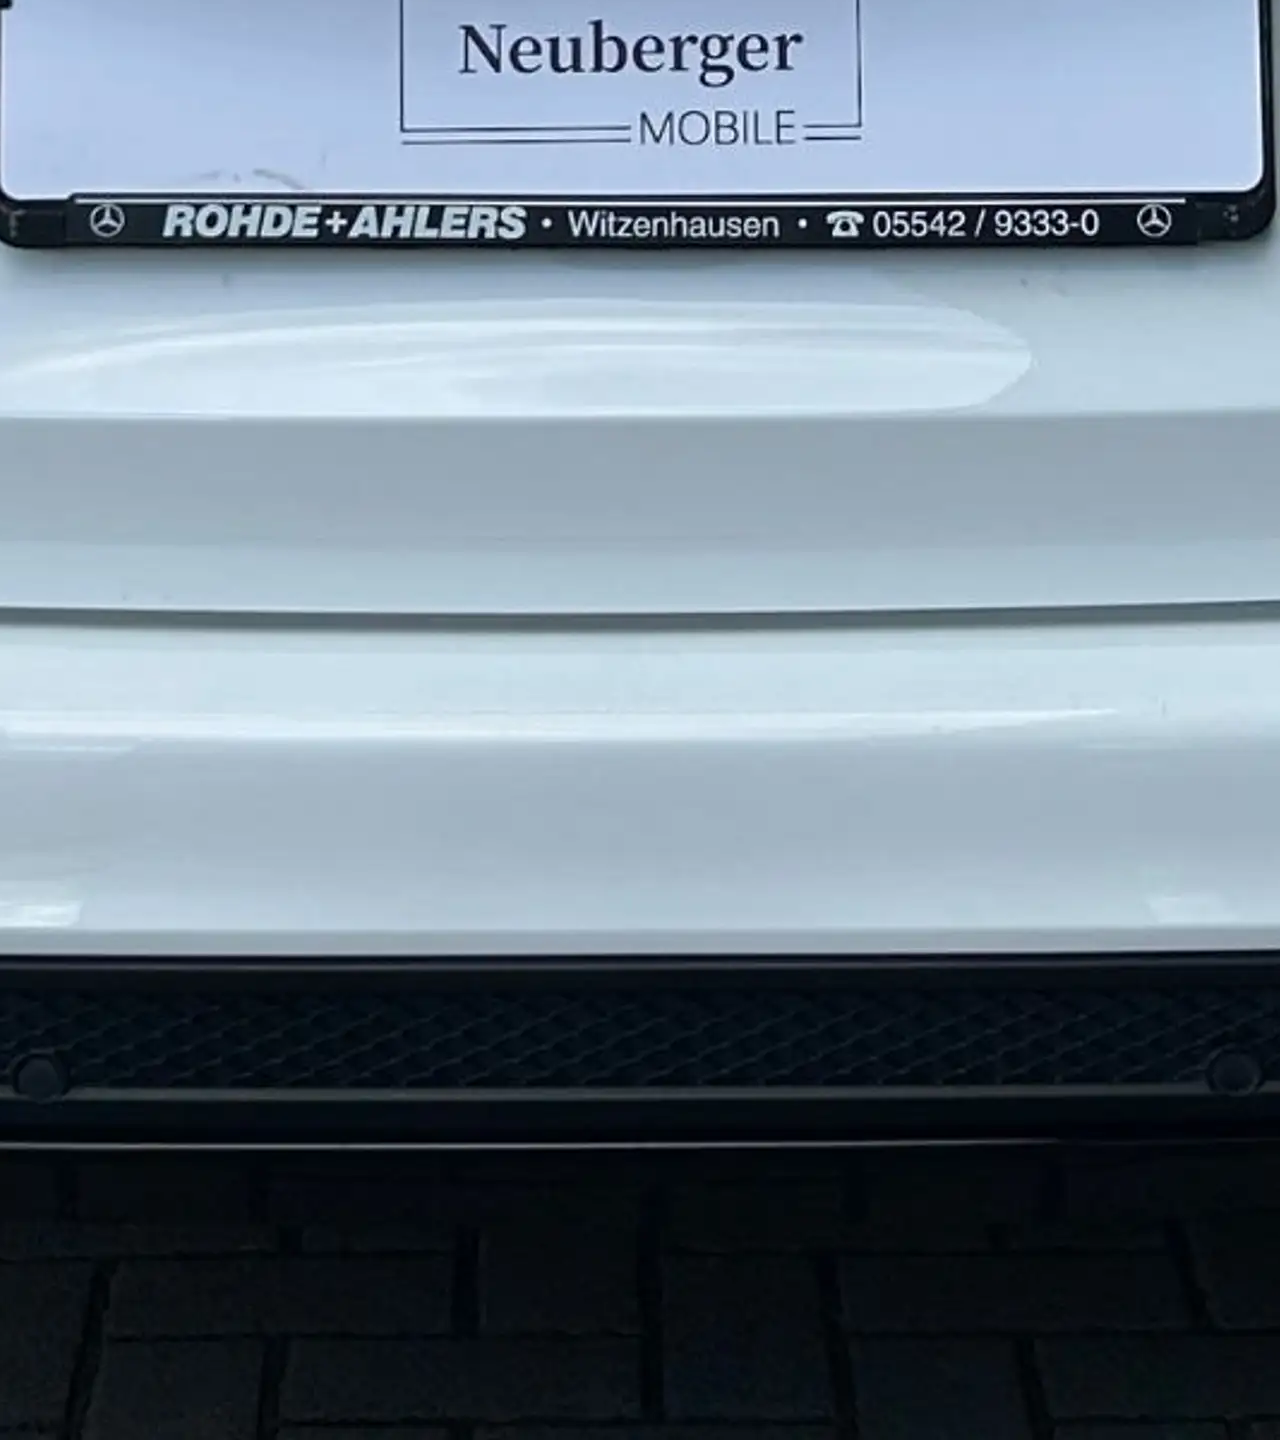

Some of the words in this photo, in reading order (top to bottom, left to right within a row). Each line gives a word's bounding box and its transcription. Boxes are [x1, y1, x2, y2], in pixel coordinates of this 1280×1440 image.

[458, 19, 804, 88] Neuberger
[639, 109, 796, 147] MOBILE
[162, 206, 527, 239] ROHDE+AHLERS
[567, 210, 780, 238] Witzenhausen
[872, 210, 967, 238] 05542
[993, 209, 1100, 238] 9333-0
